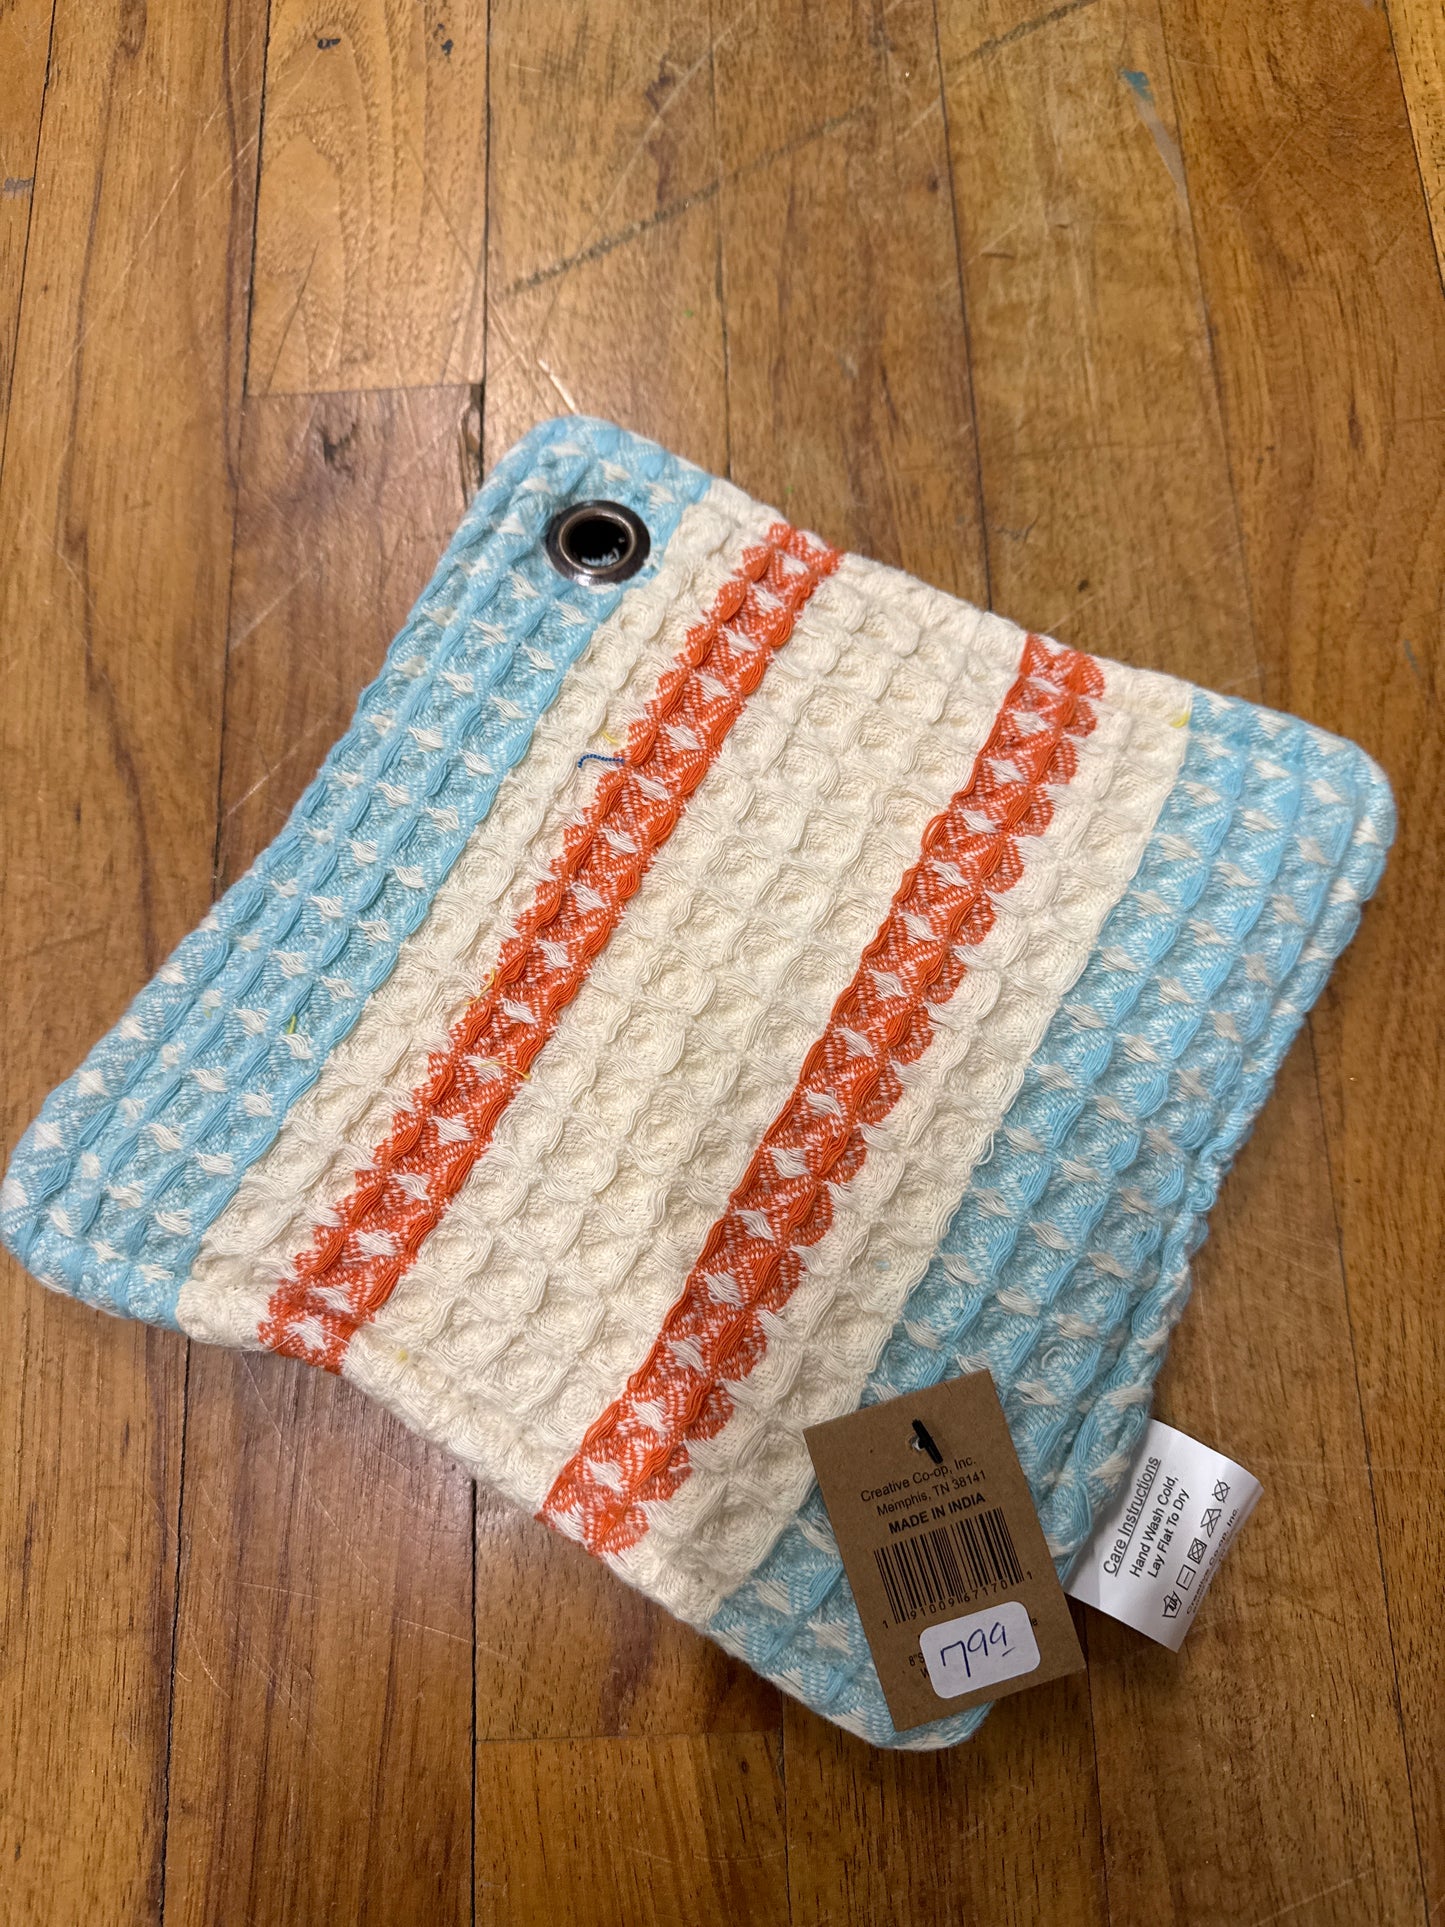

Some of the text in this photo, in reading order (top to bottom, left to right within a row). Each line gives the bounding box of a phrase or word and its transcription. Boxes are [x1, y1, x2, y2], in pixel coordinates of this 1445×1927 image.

[861, 1456, 976, 1502] Creative Co-op, Inc.
[877, 1470, 986, 1516] Memphis, TN 38141
[888, 1492, 986, 1534] MADE IN INDIA
[1103, 1456, 1161, 1576] Care Instructions
[1129, 1476, 1179, 1578] Hand Wash Cold,
[1147, 1488, 1190, 1579] Lay Flat To Dry
[883, 1620, 889, 1629] 1
[1026, 1570, 1033, 1580] 1
